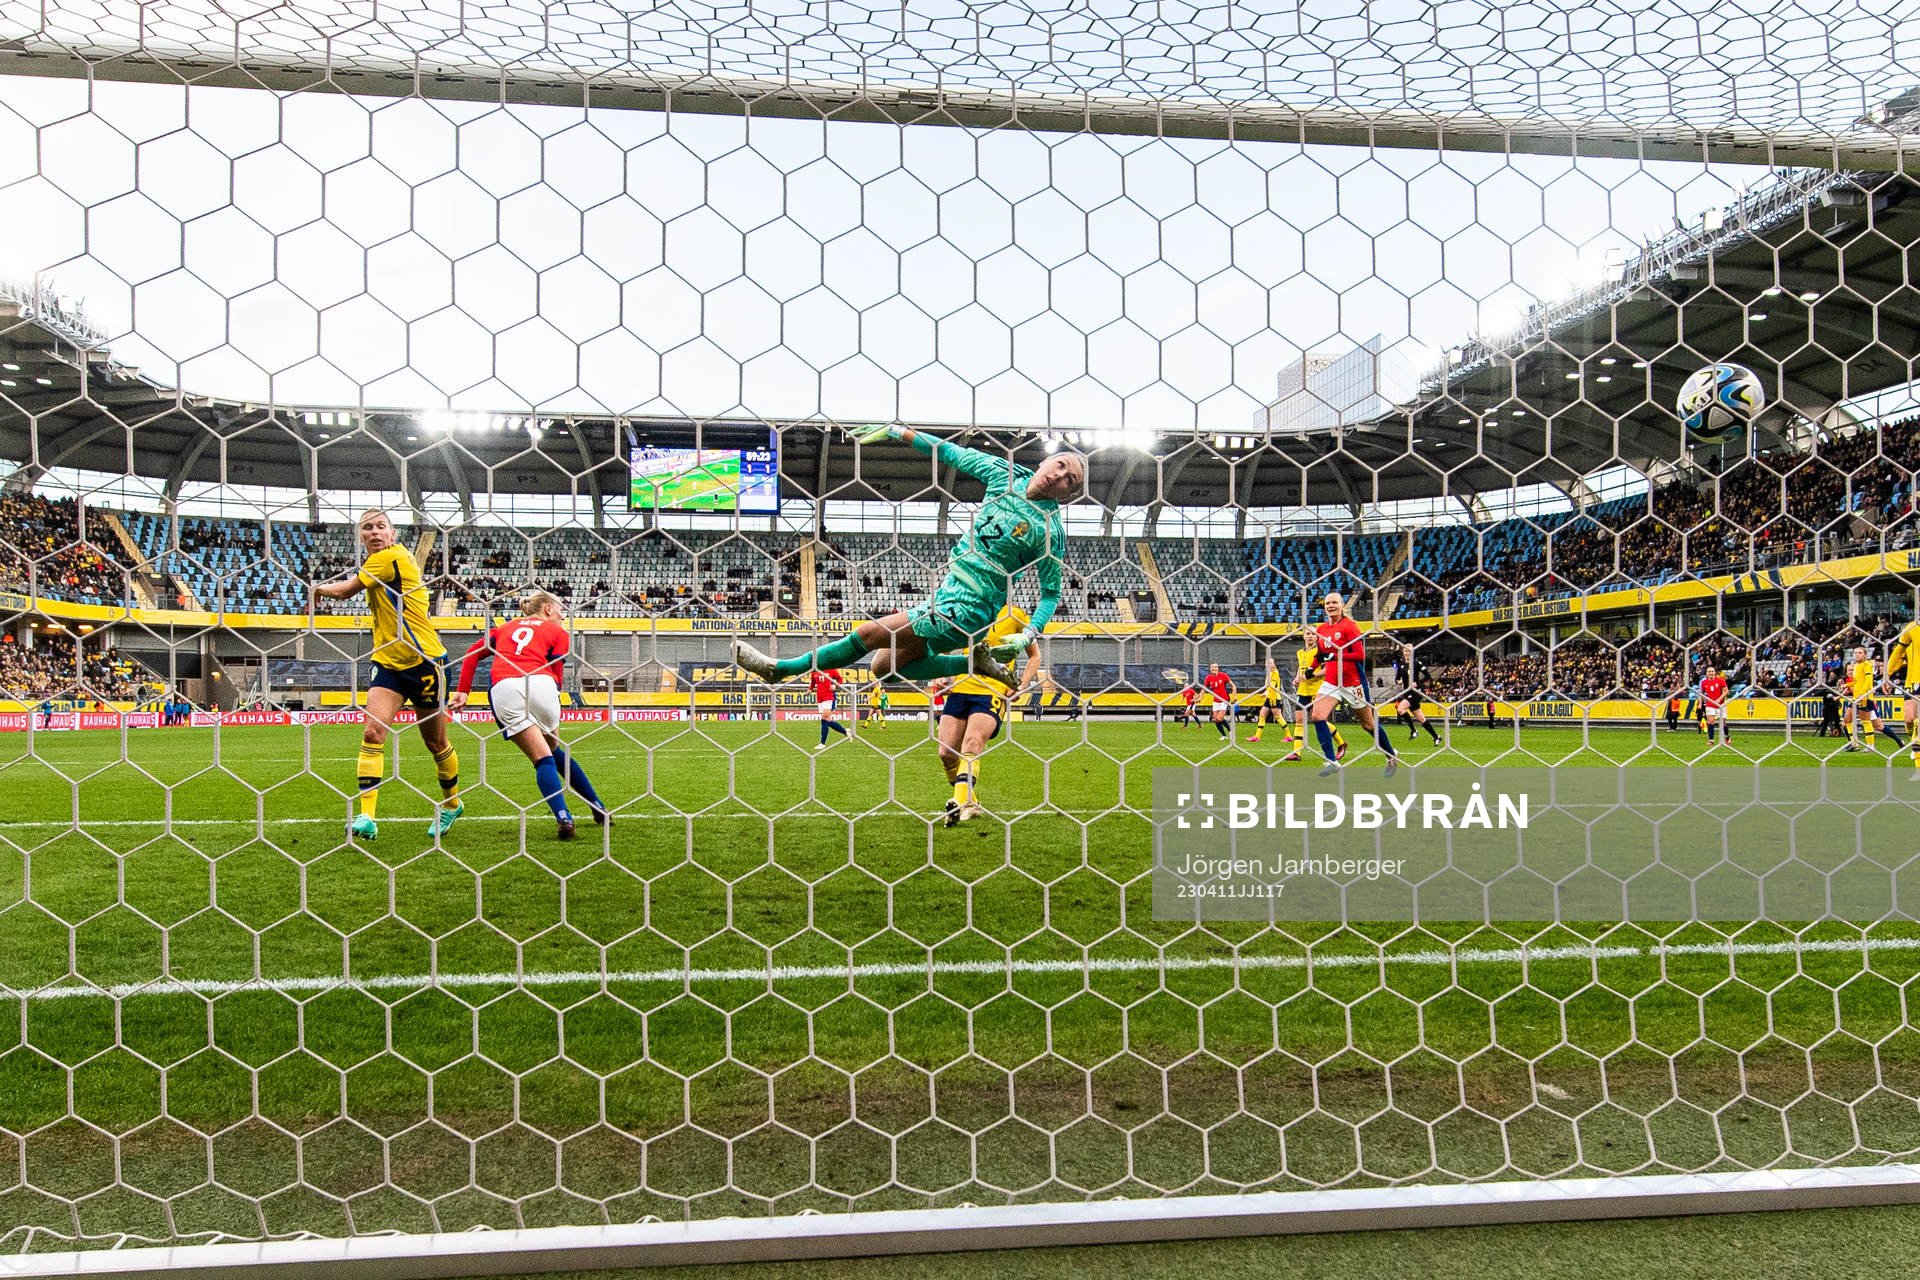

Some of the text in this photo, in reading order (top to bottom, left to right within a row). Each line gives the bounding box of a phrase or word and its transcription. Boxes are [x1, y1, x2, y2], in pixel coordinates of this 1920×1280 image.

[511, 626, 534, 656] 9
[420, 674, 436, 696] 2
[83, 715, 118, 726] BAUHAUS
[300, 712, 365, 723] BAUHAUS
[618, 710, 679, 721] BAUHAUS
